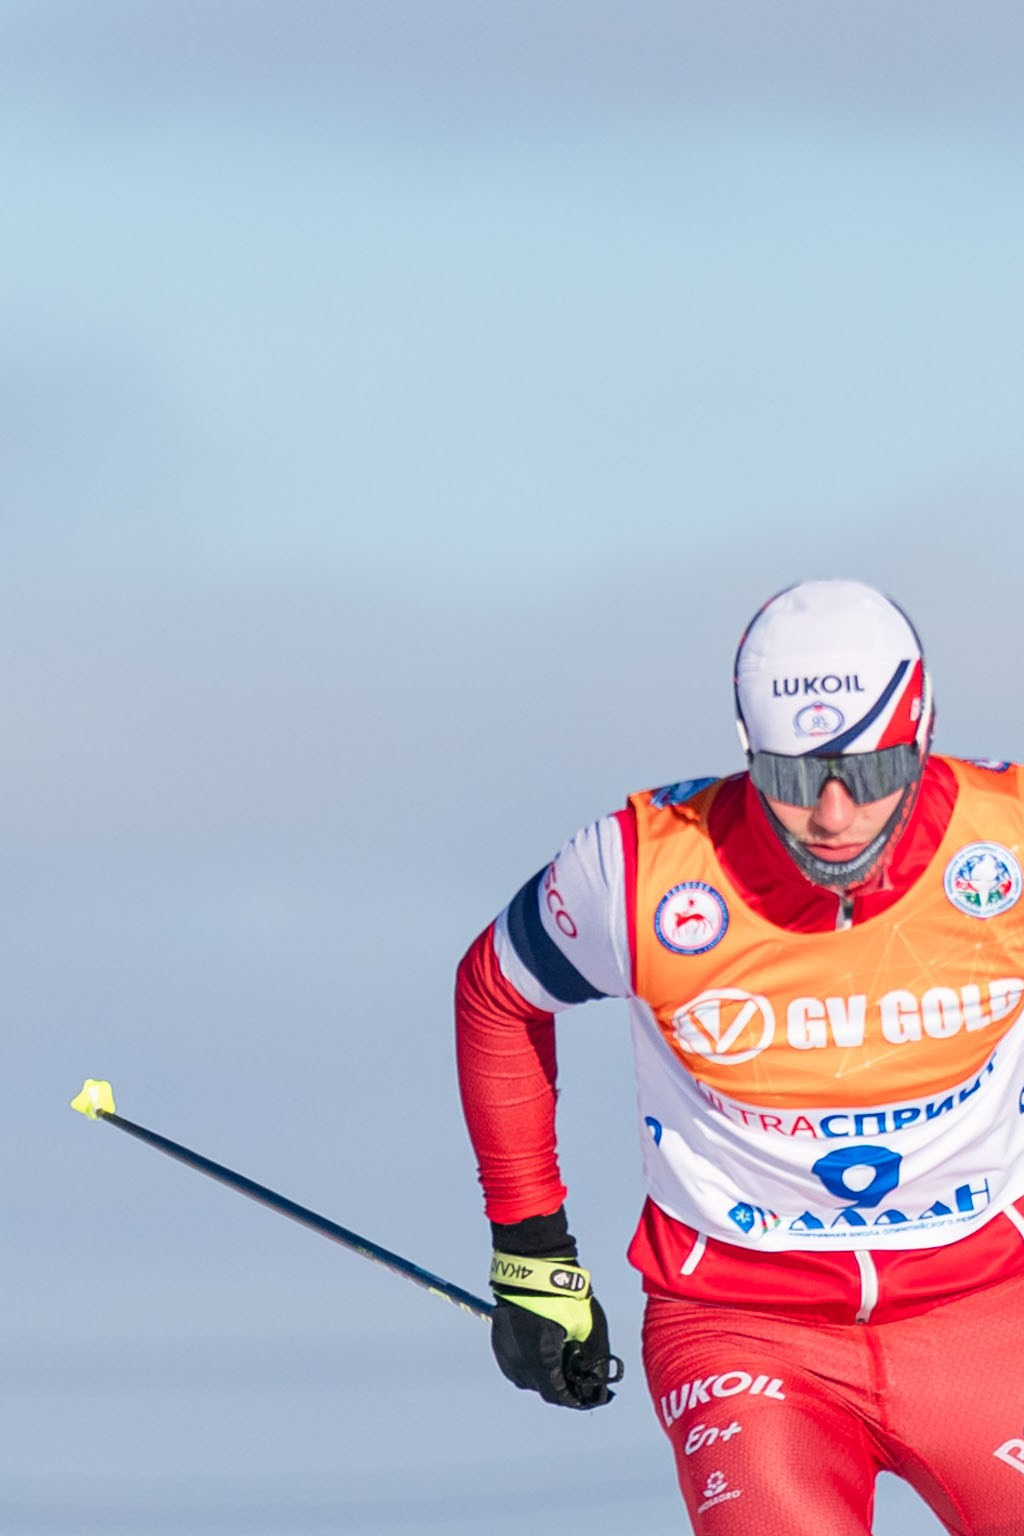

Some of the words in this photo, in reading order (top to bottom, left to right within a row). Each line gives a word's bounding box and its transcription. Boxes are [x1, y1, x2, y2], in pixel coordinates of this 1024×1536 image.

[773, 674, 865, 697] LUKOIL
[787, 994, 867, 1050] GV
[876, 977, 1024, 1045] GOLD
[660, 1371, 786, 1428] LUKOIL
